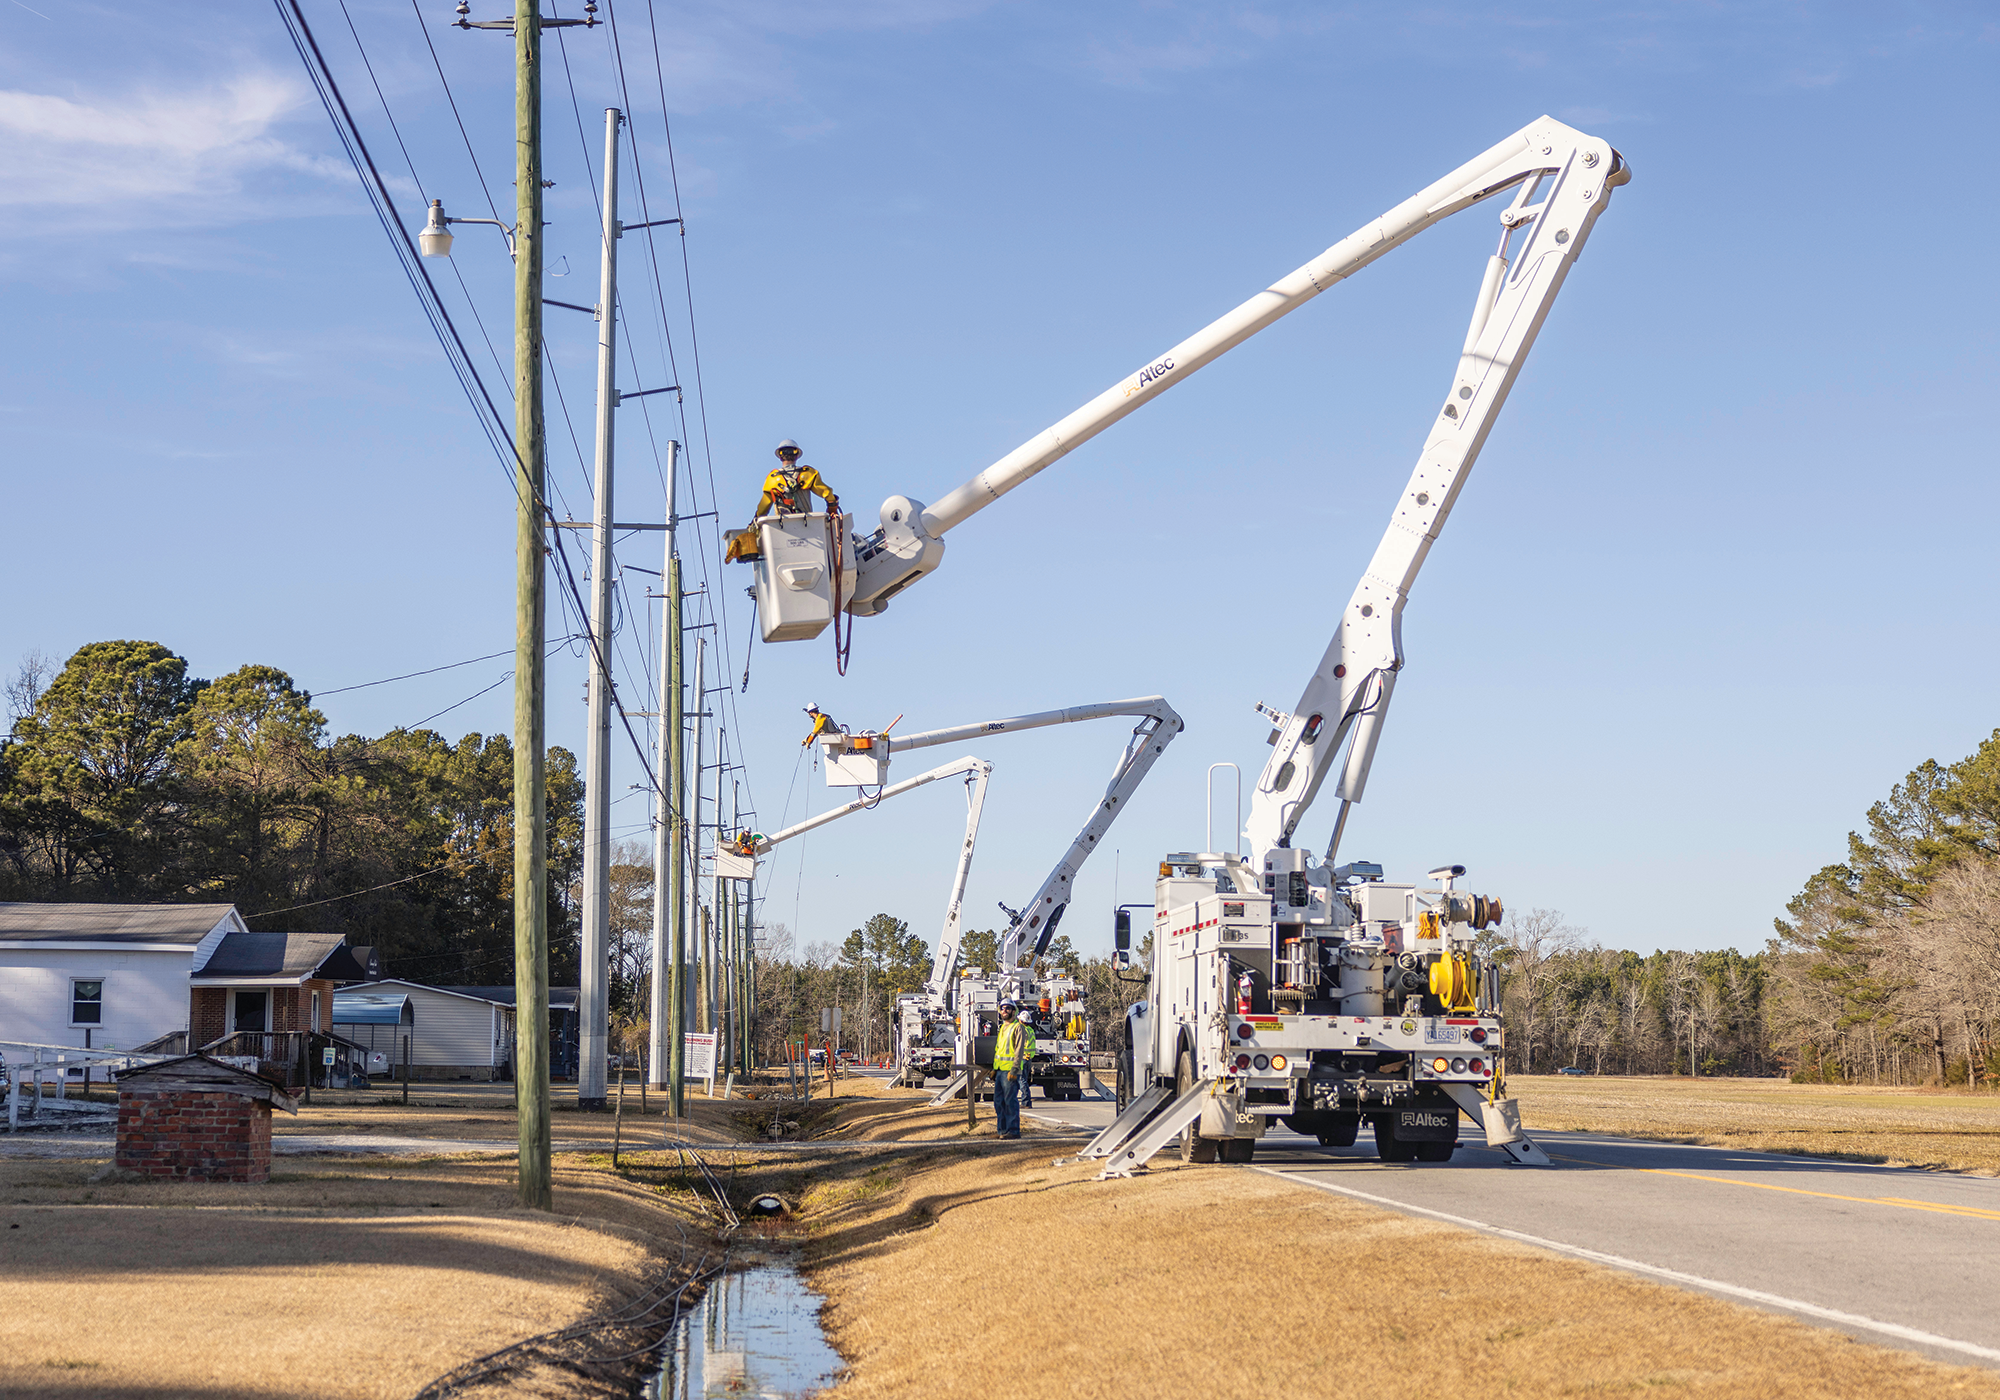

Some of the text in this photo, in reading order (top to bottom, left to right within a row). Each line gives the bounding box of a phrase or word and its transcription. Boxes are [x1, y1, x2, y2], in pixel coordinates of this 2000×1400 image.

[1139, 357, 1175, 388] Altec
[988, 722, 1005, 731] Altec
[1235, 1109, 1255, 1124] tec
[1415, 1112, 1448, 1127] Altec
